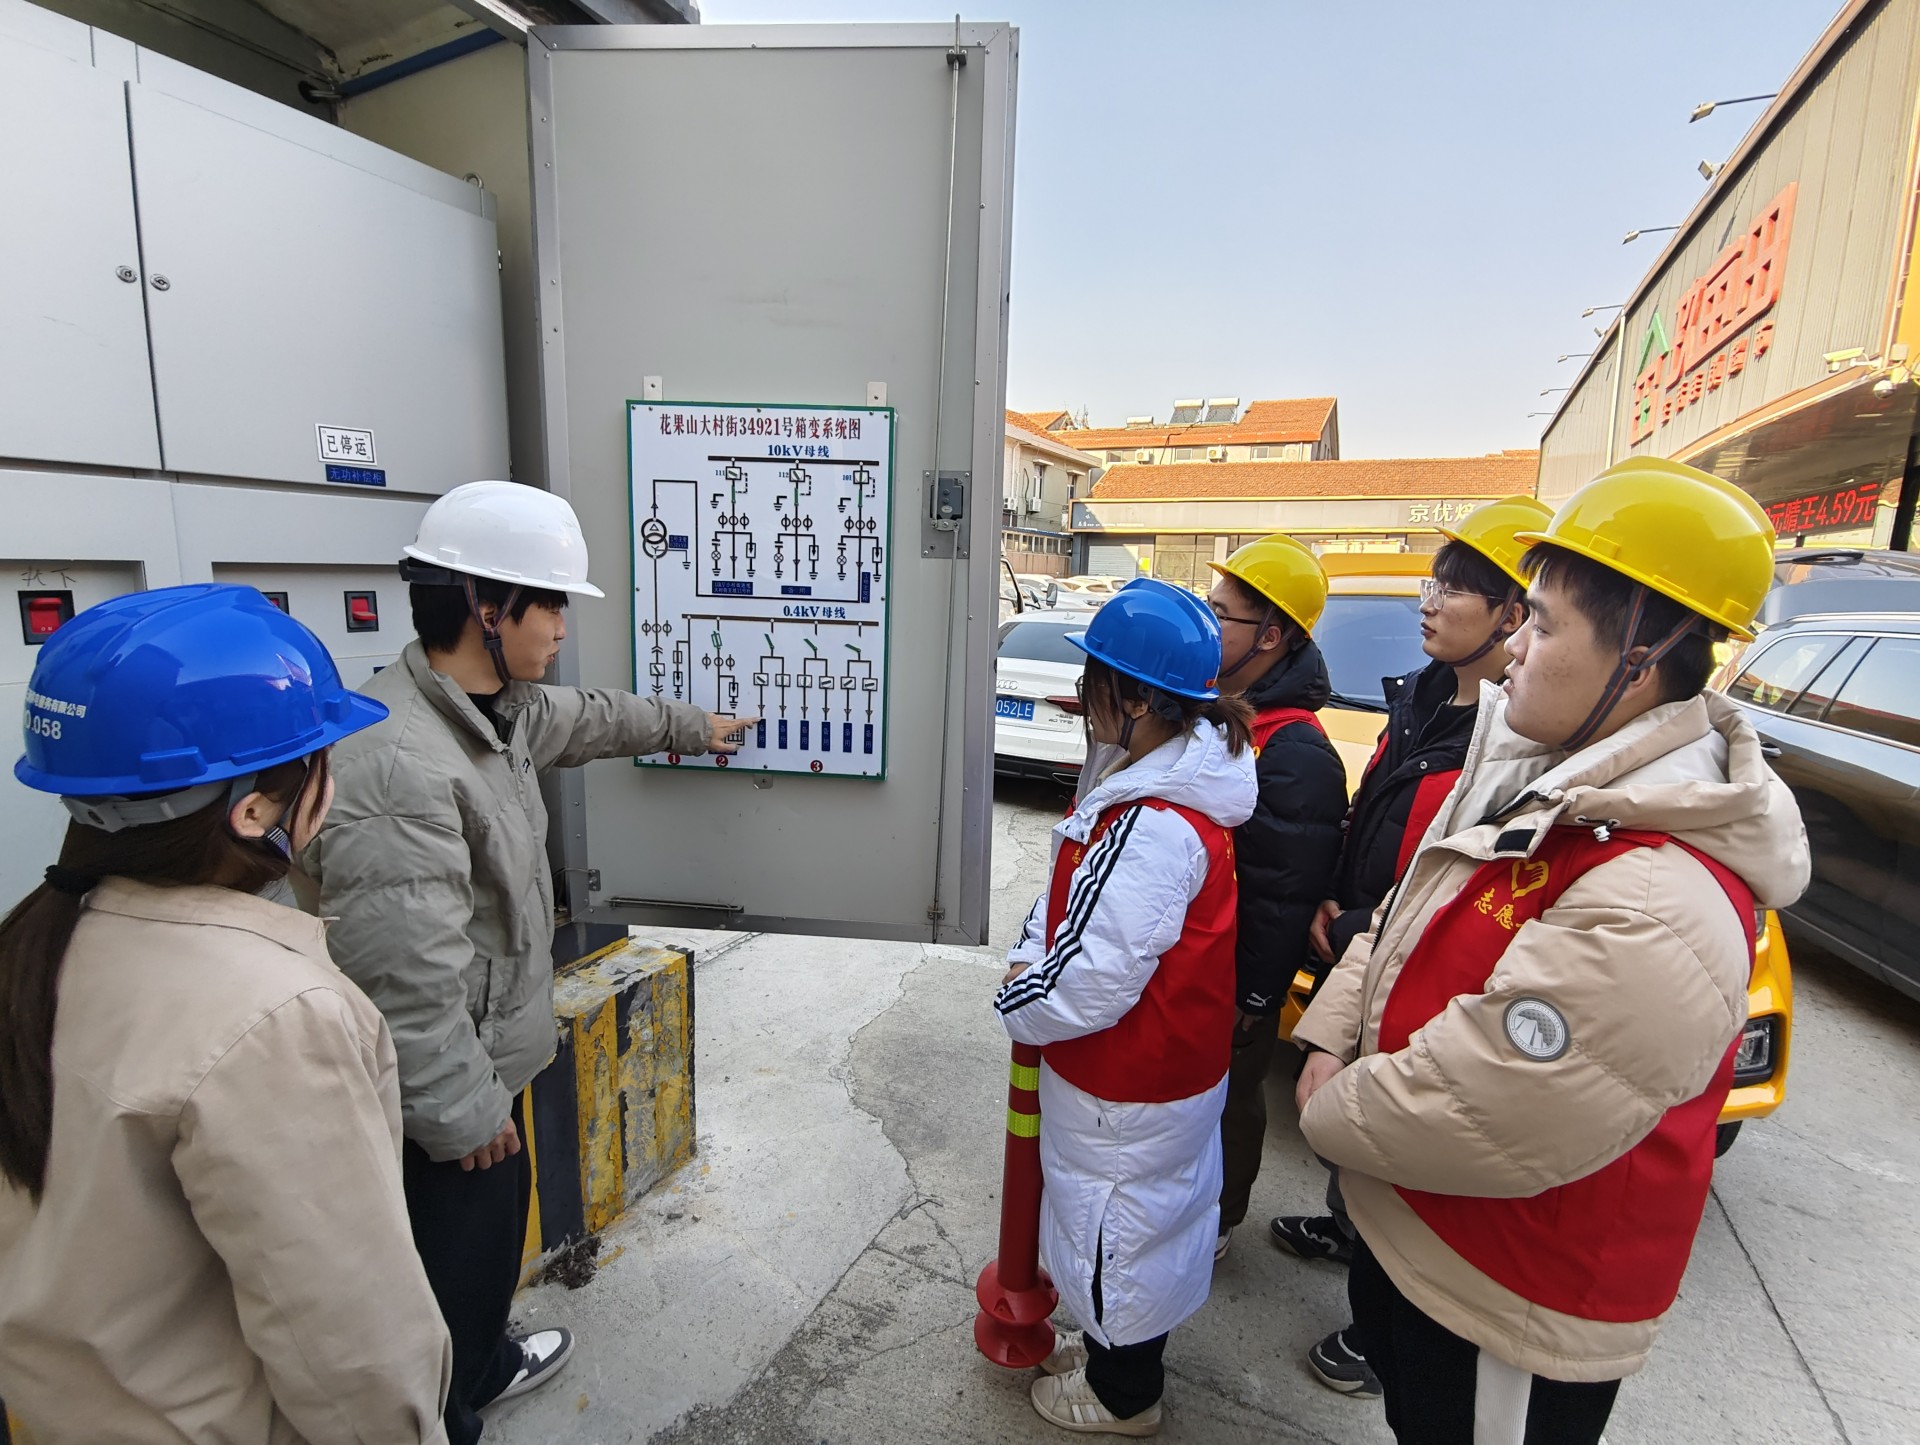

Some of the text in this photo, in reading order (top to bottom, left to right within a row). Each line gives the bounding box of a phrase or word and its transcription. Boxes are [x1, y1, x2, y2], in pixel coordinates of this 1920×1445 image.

[659, 413, 861, 440] 花果山大村街34921号箱变系统图
[326, 434, 367, 456] 已停运
[767, 444, 830, 458] 10kV母线
[330, 467, 383, 484] 无功补偿柜
[783, 605, 846, 618] 0.4kV母线
[1473, 887, 1523, 930] 志愿
